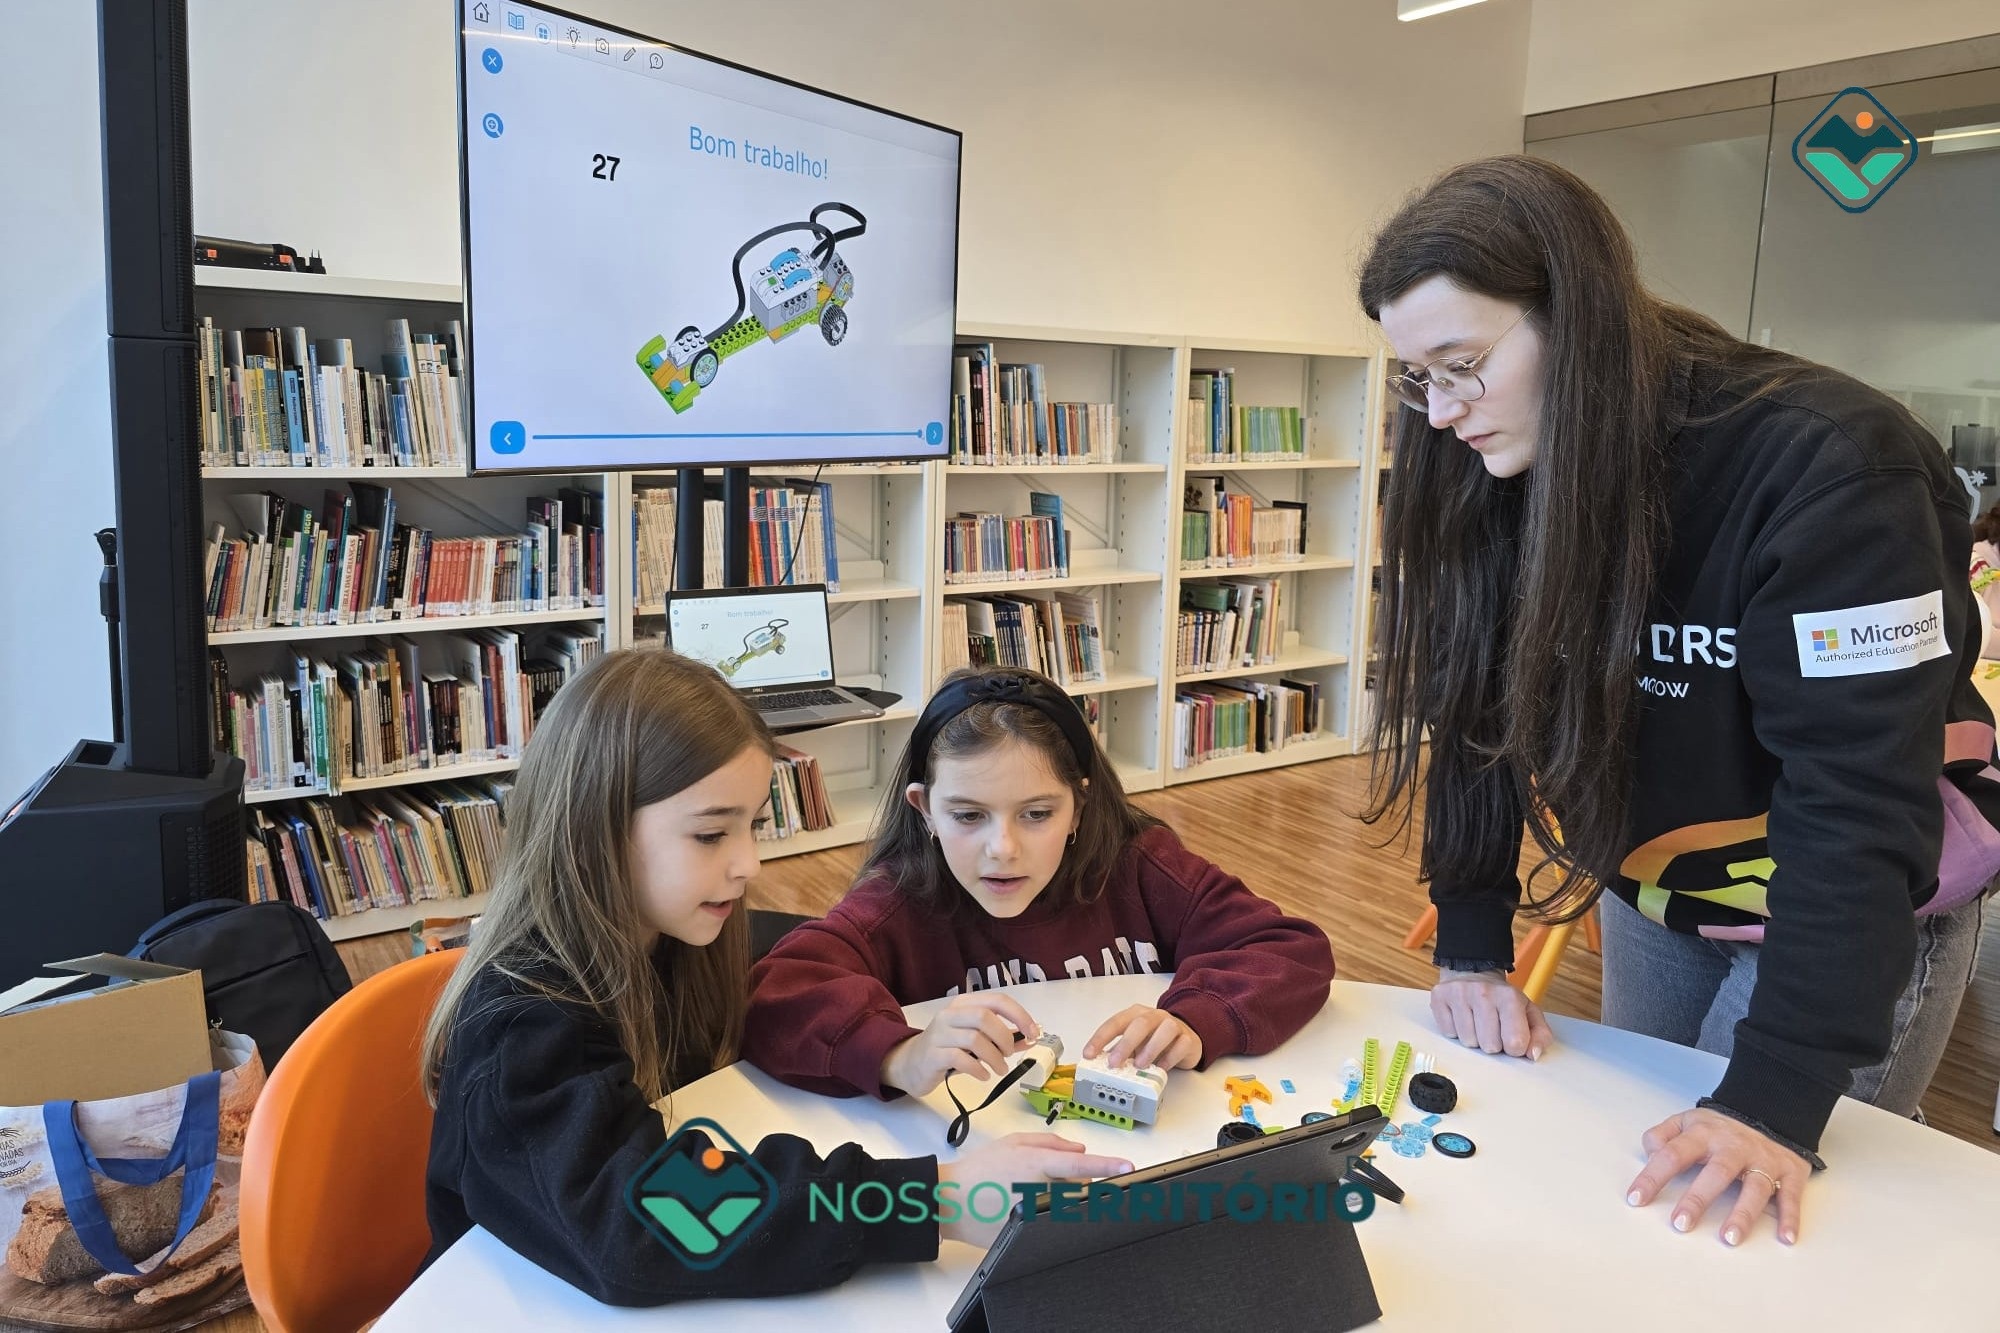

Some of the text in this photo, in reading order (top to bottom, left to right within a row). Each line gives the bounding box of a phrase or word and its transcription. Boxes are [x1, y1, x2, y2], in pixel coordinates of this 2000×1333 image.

[592, 153, 621, 182] 27
[689, 125, 829, 181] Bom trabalho!
[1850, 611, 1938, 646] Microsoft
[1815, 649, 1873, 663] Authorized
[1876, 642, 1920, 657] Education
